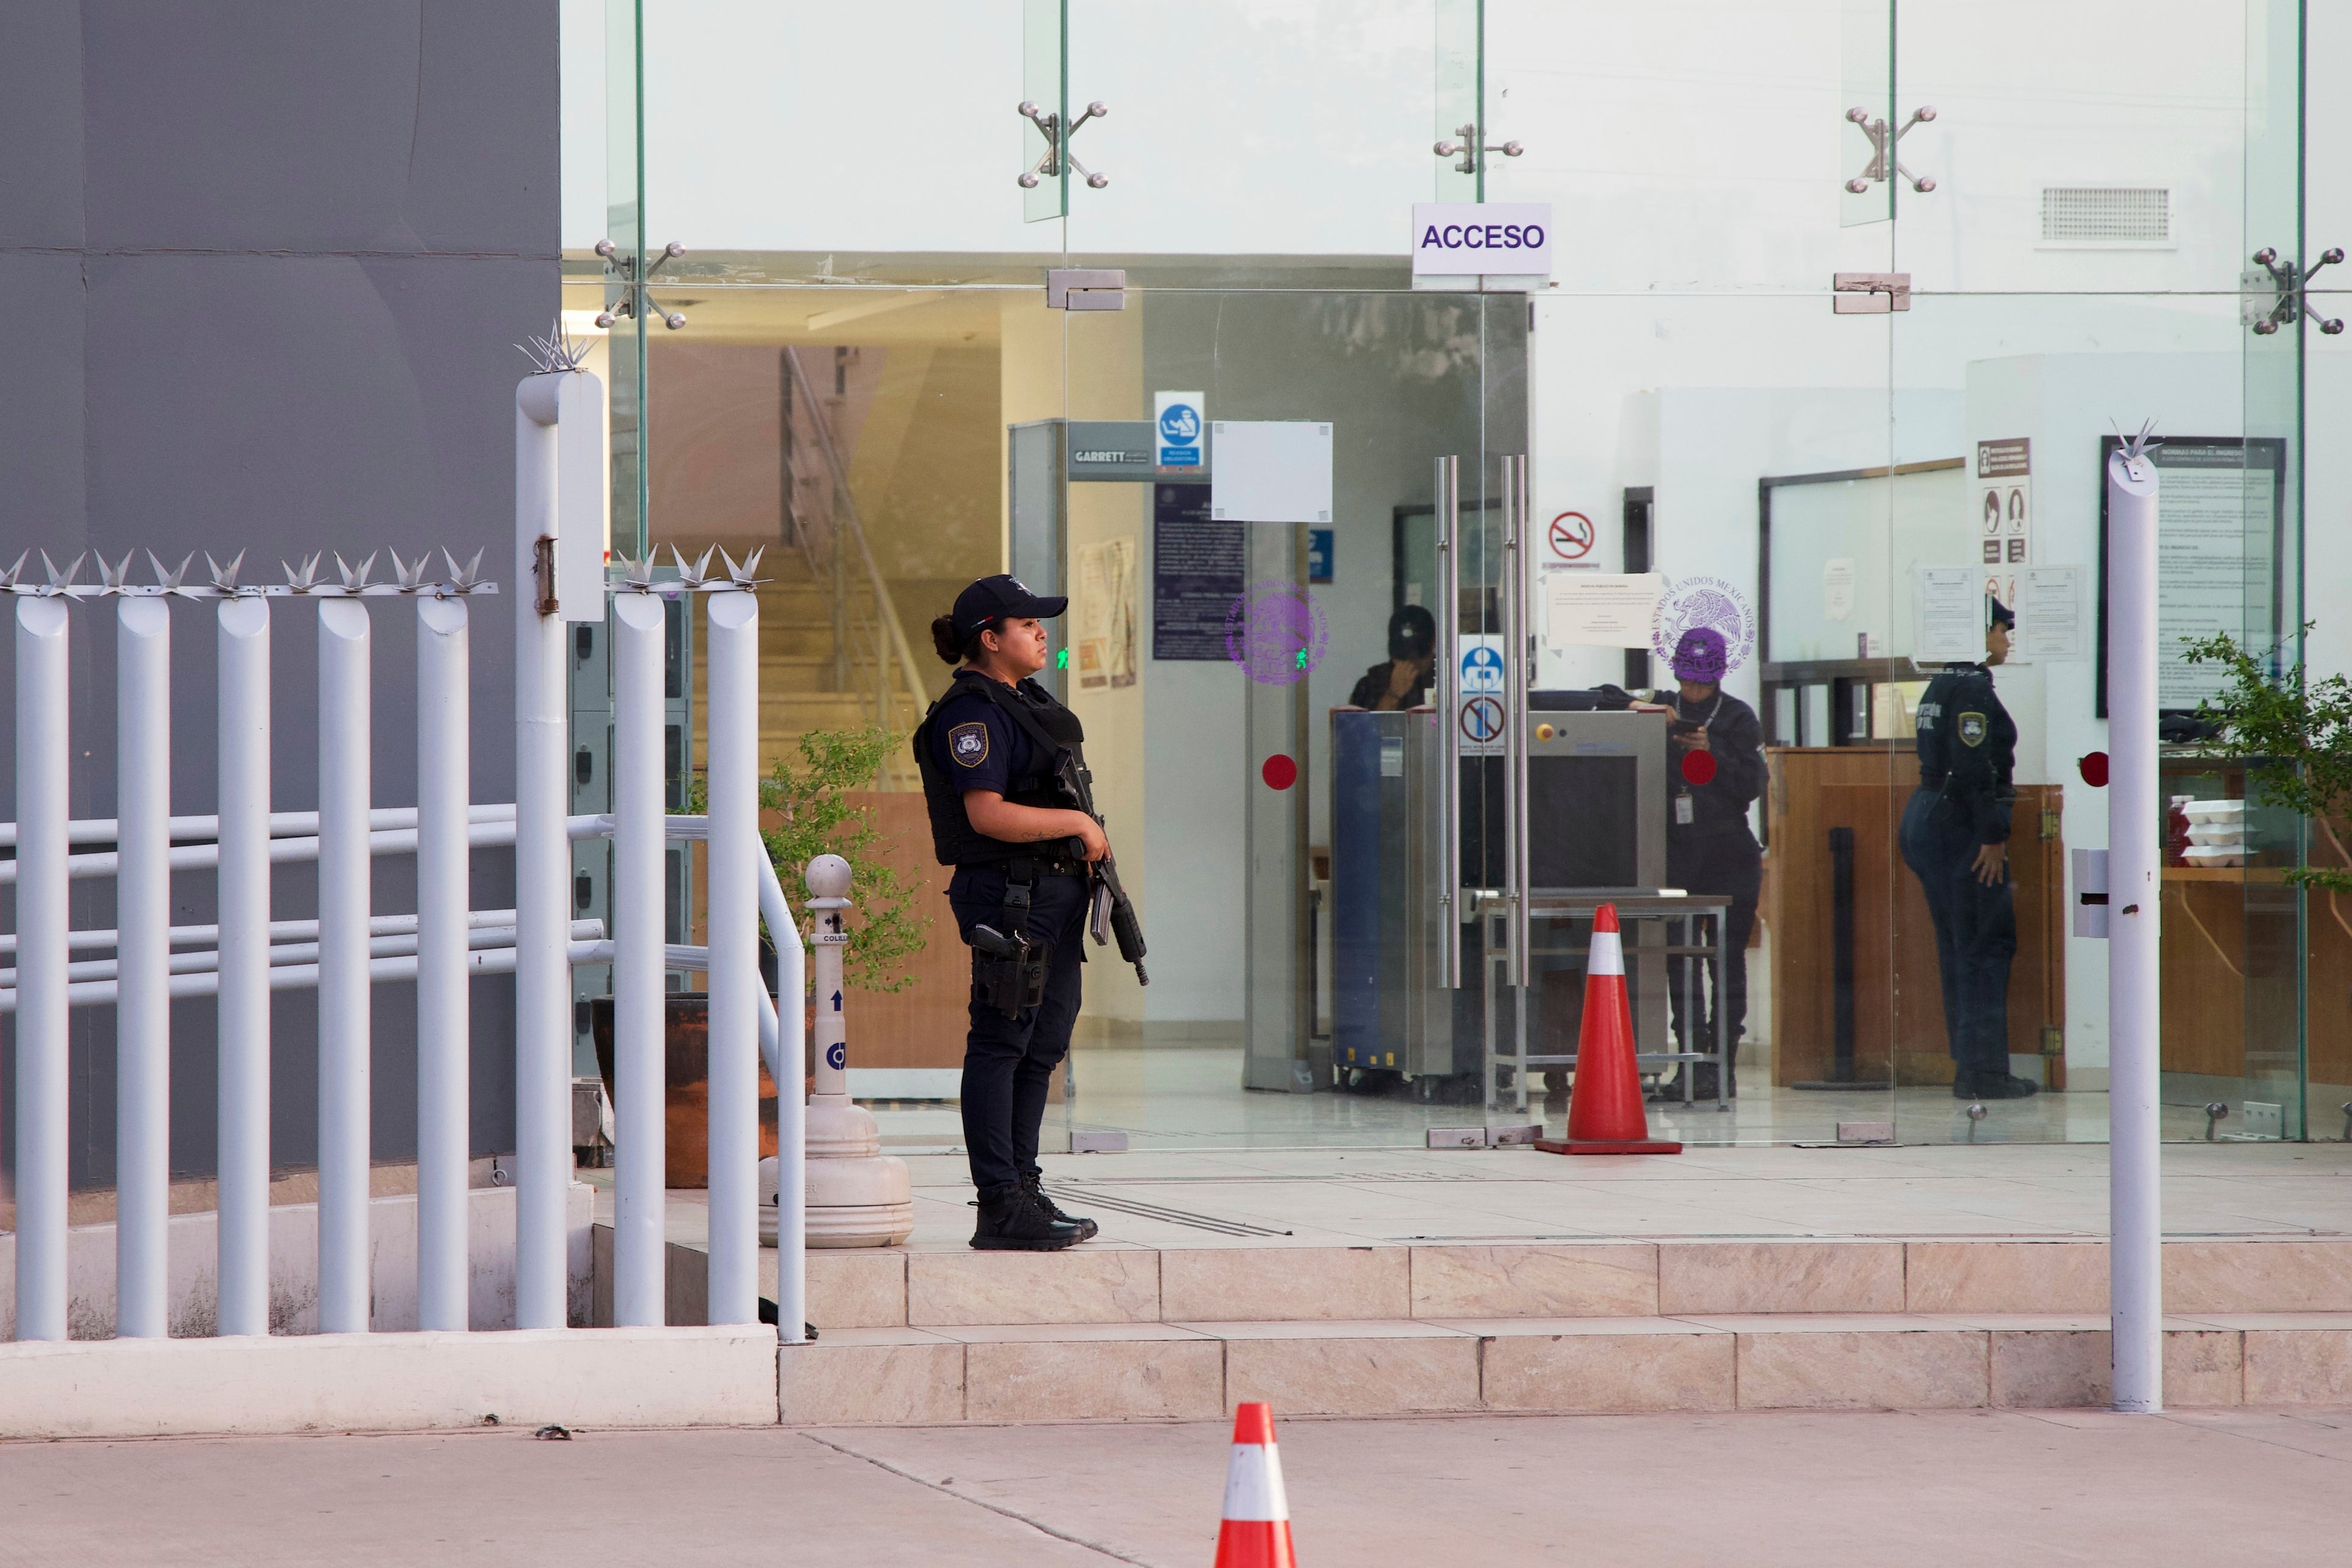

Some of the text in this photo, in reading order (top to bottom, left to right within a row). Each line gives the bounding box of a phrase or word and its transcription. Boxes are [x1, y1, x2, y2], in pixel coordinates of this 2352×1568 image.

[1421, 225, 1544, 248] ACCESO
[1075, 451, 1125, 462] GARRETT
[1652, 588, 1676, 630] ESTADOS
[1676, 577, 1714, 591] UNIDOS
[1716, 579, 1754, 628] MEXICANOS
